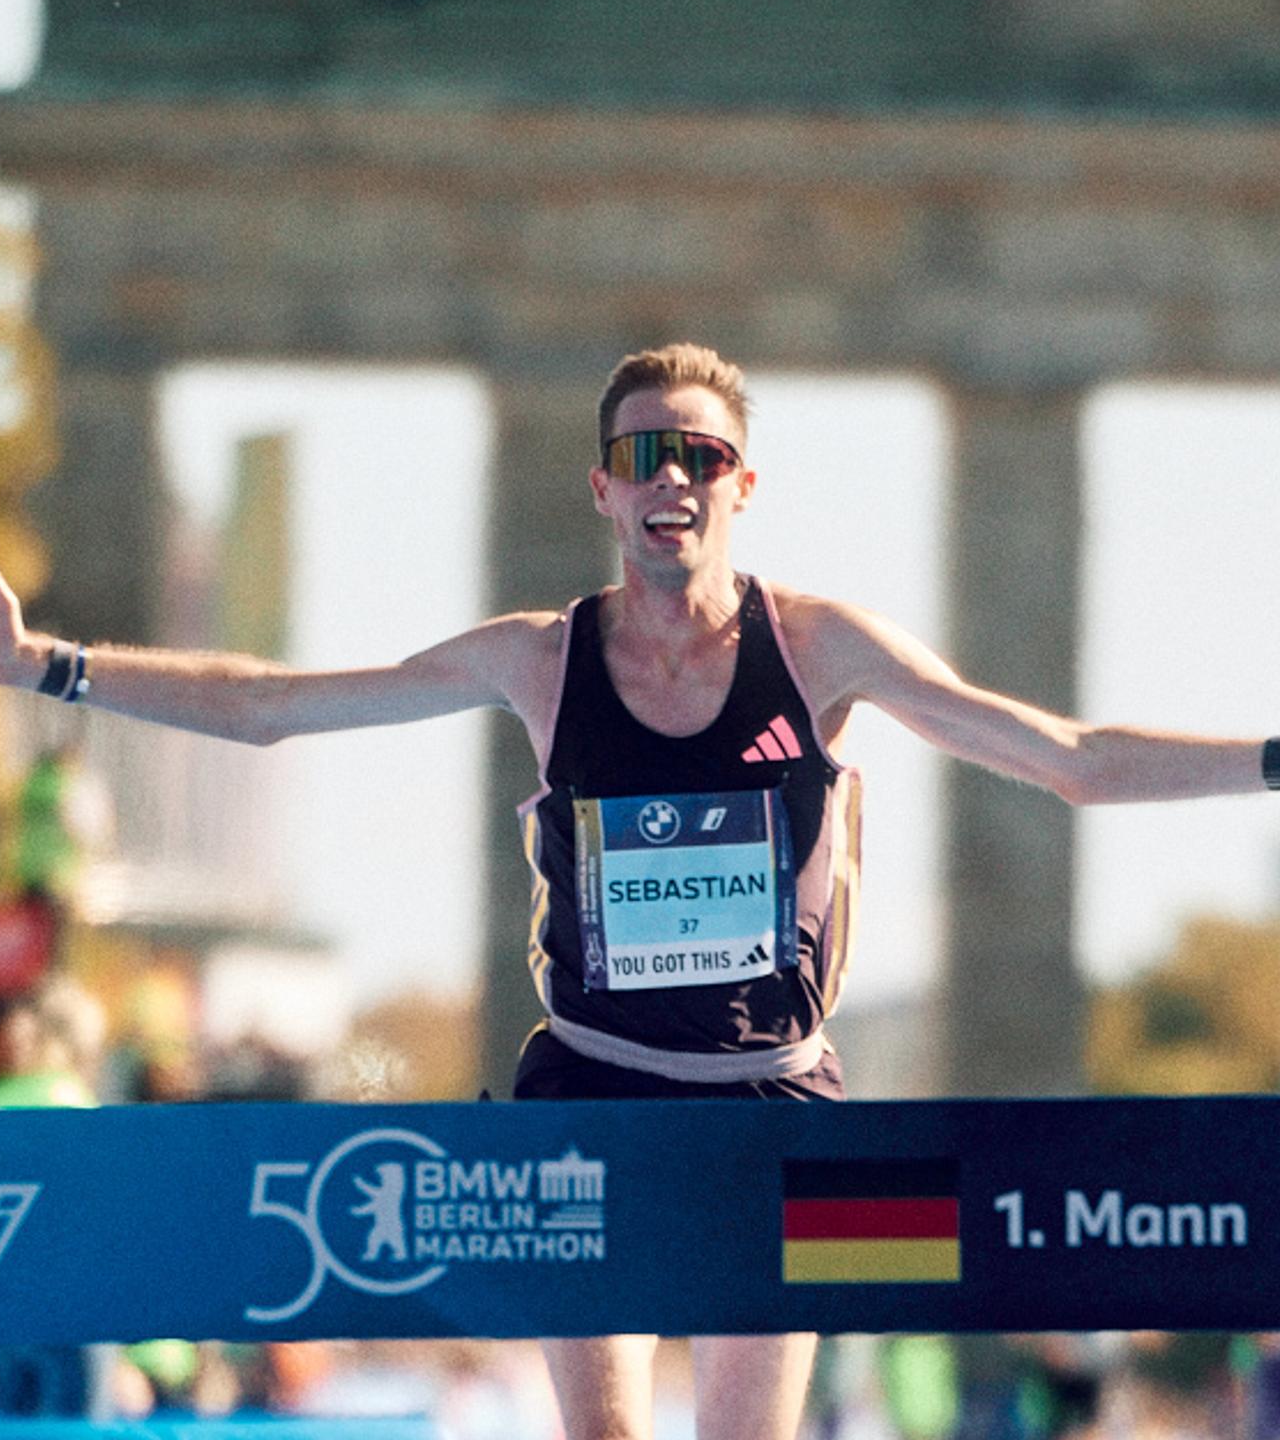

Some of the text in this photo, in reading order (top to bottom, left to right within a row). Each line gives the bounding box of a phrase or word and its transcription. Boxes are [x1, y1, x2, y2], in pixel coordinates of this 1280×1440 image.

[608, 873, 766, 903] SEBASTIAN
[679, 918, 700, 934] 37
[612, 950, 732, 976] YOU GOT THIS
[414, 1161, 532, 1200] BMW
[243, 1127, 448, 1322] 50
[414, 1204, 536, 1230] BERLIN
[993, 1190, 1248, 1248] 1. Mann
[414, 1234, 605, 1260] MARATHON
